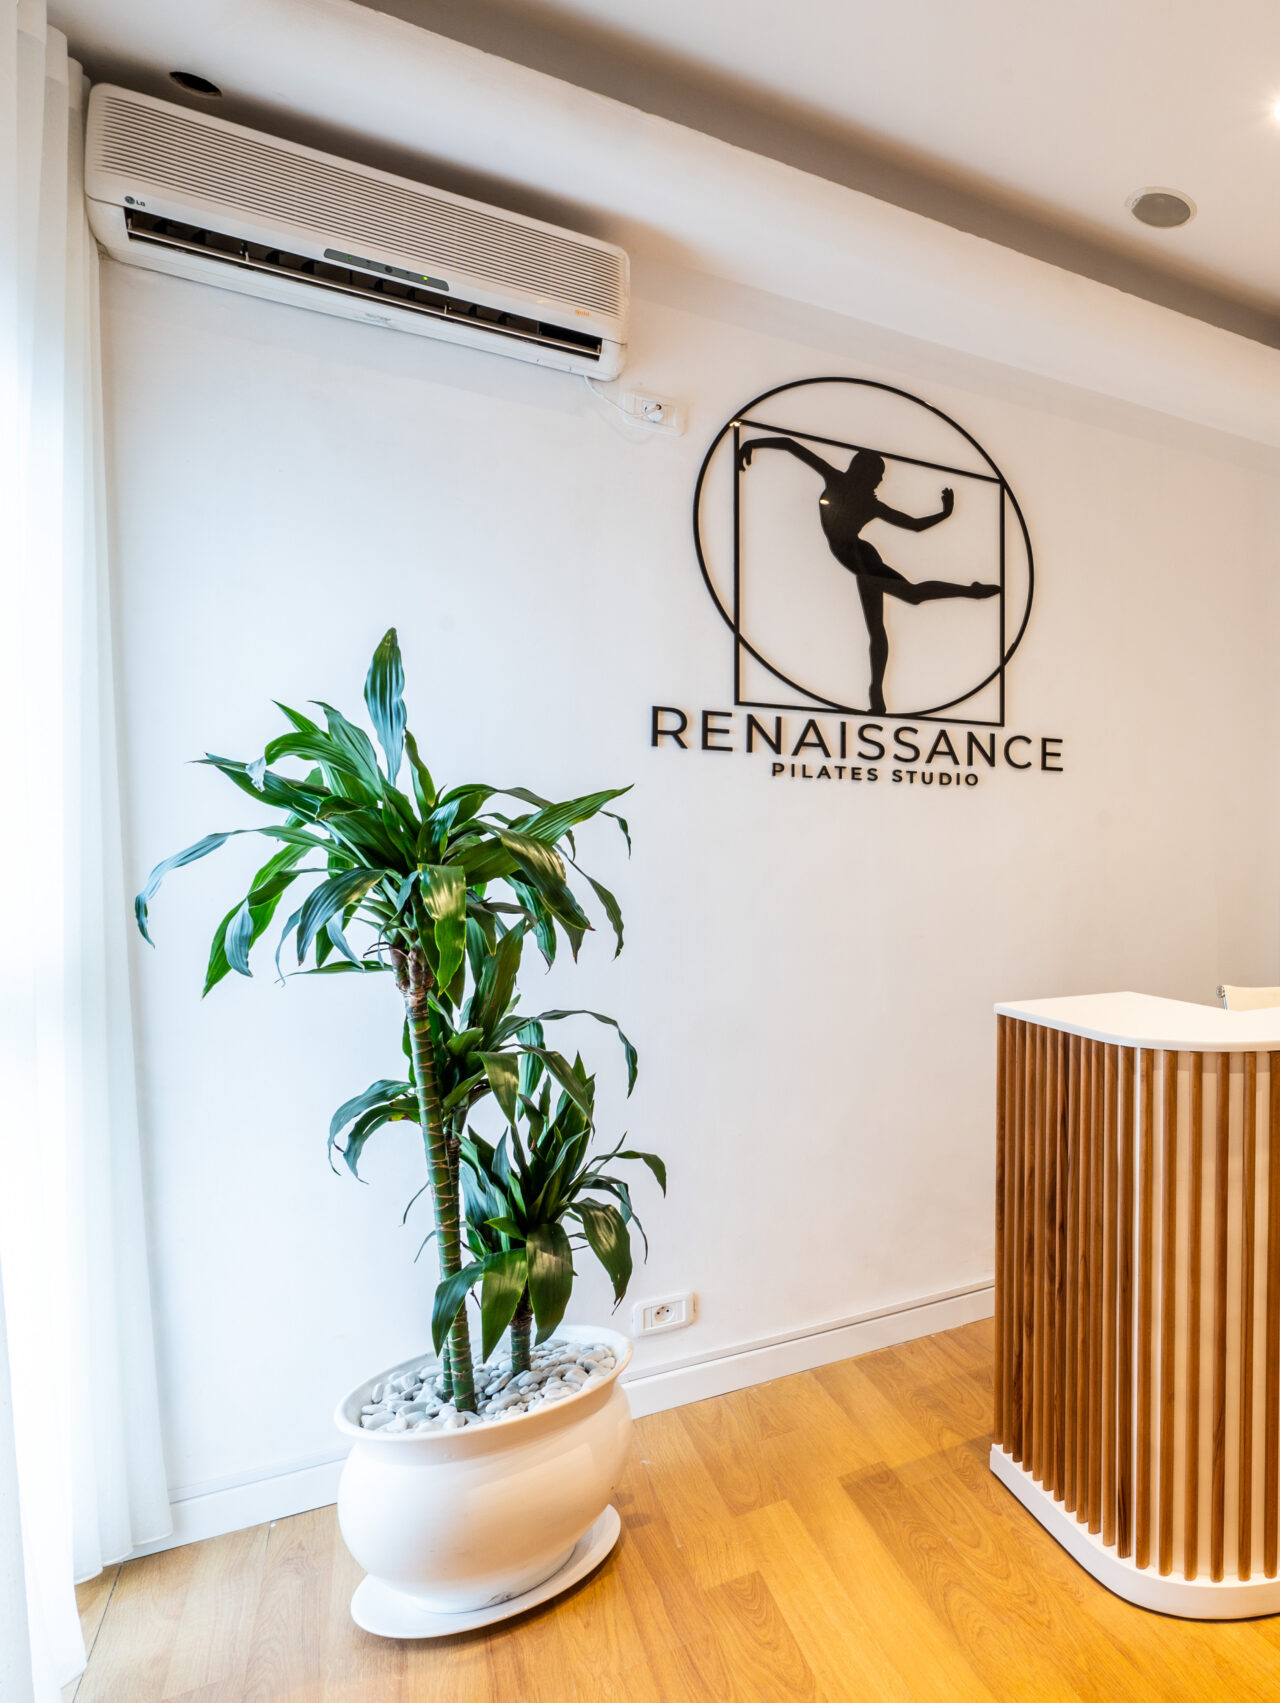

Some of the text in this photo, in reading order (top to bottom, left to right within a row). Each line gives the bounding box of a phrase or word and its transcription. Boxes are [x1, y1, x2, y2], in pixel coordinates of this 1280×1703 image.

[651, 705, 1064, 772] RENAISSANCE
[771, 762, 979, 787] PILATES STUDIO
